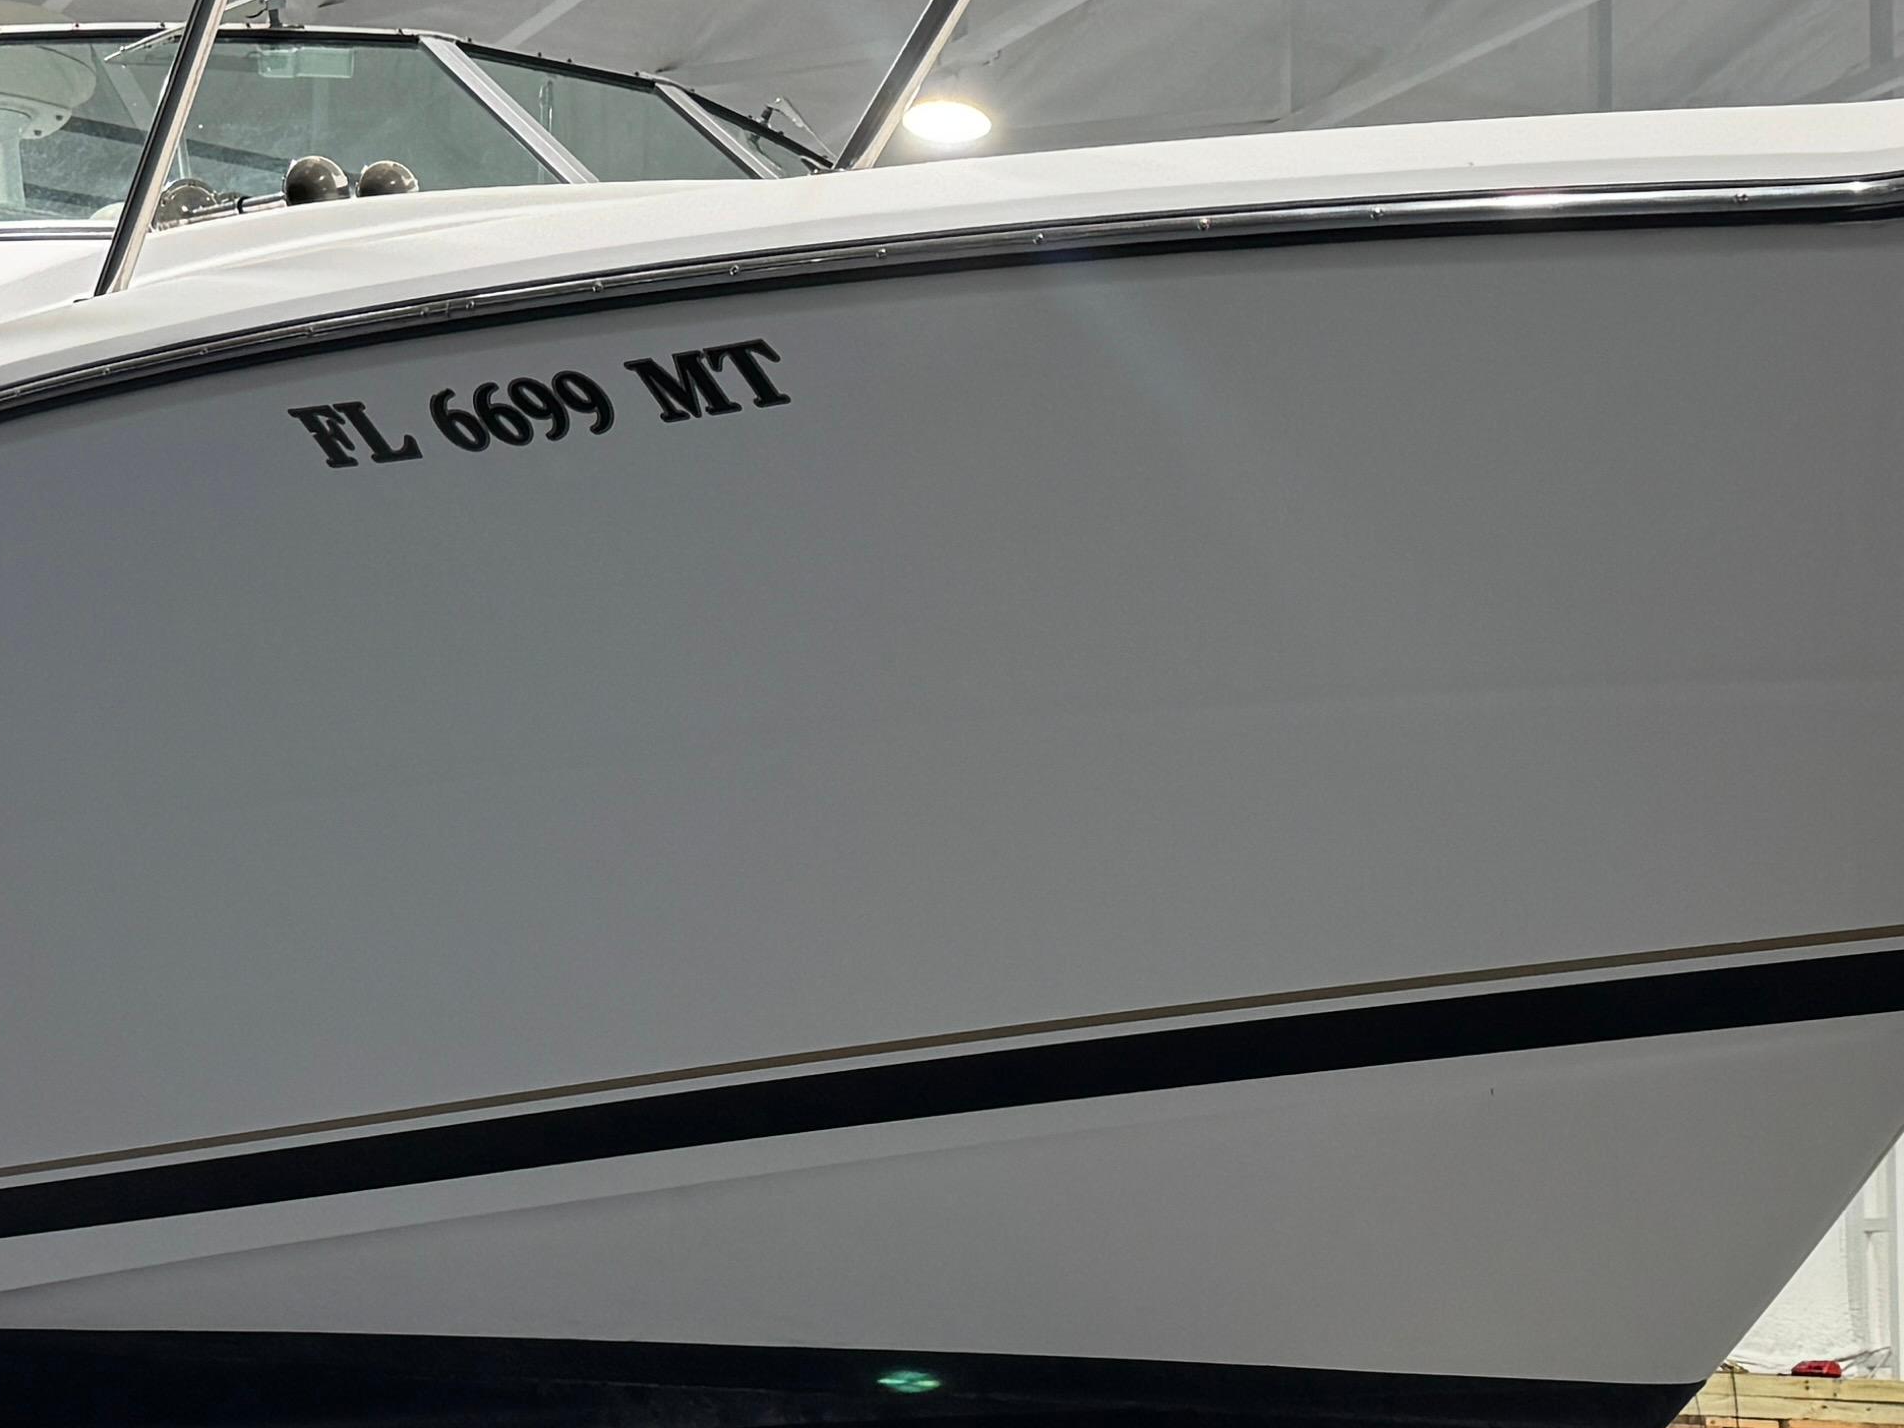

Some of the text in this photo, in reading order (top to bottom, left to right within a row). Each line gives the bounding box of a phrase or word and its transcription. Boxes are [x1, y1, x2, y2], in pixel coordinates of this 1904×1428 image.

[287, 338, 792, 469] FL 6699 MT
